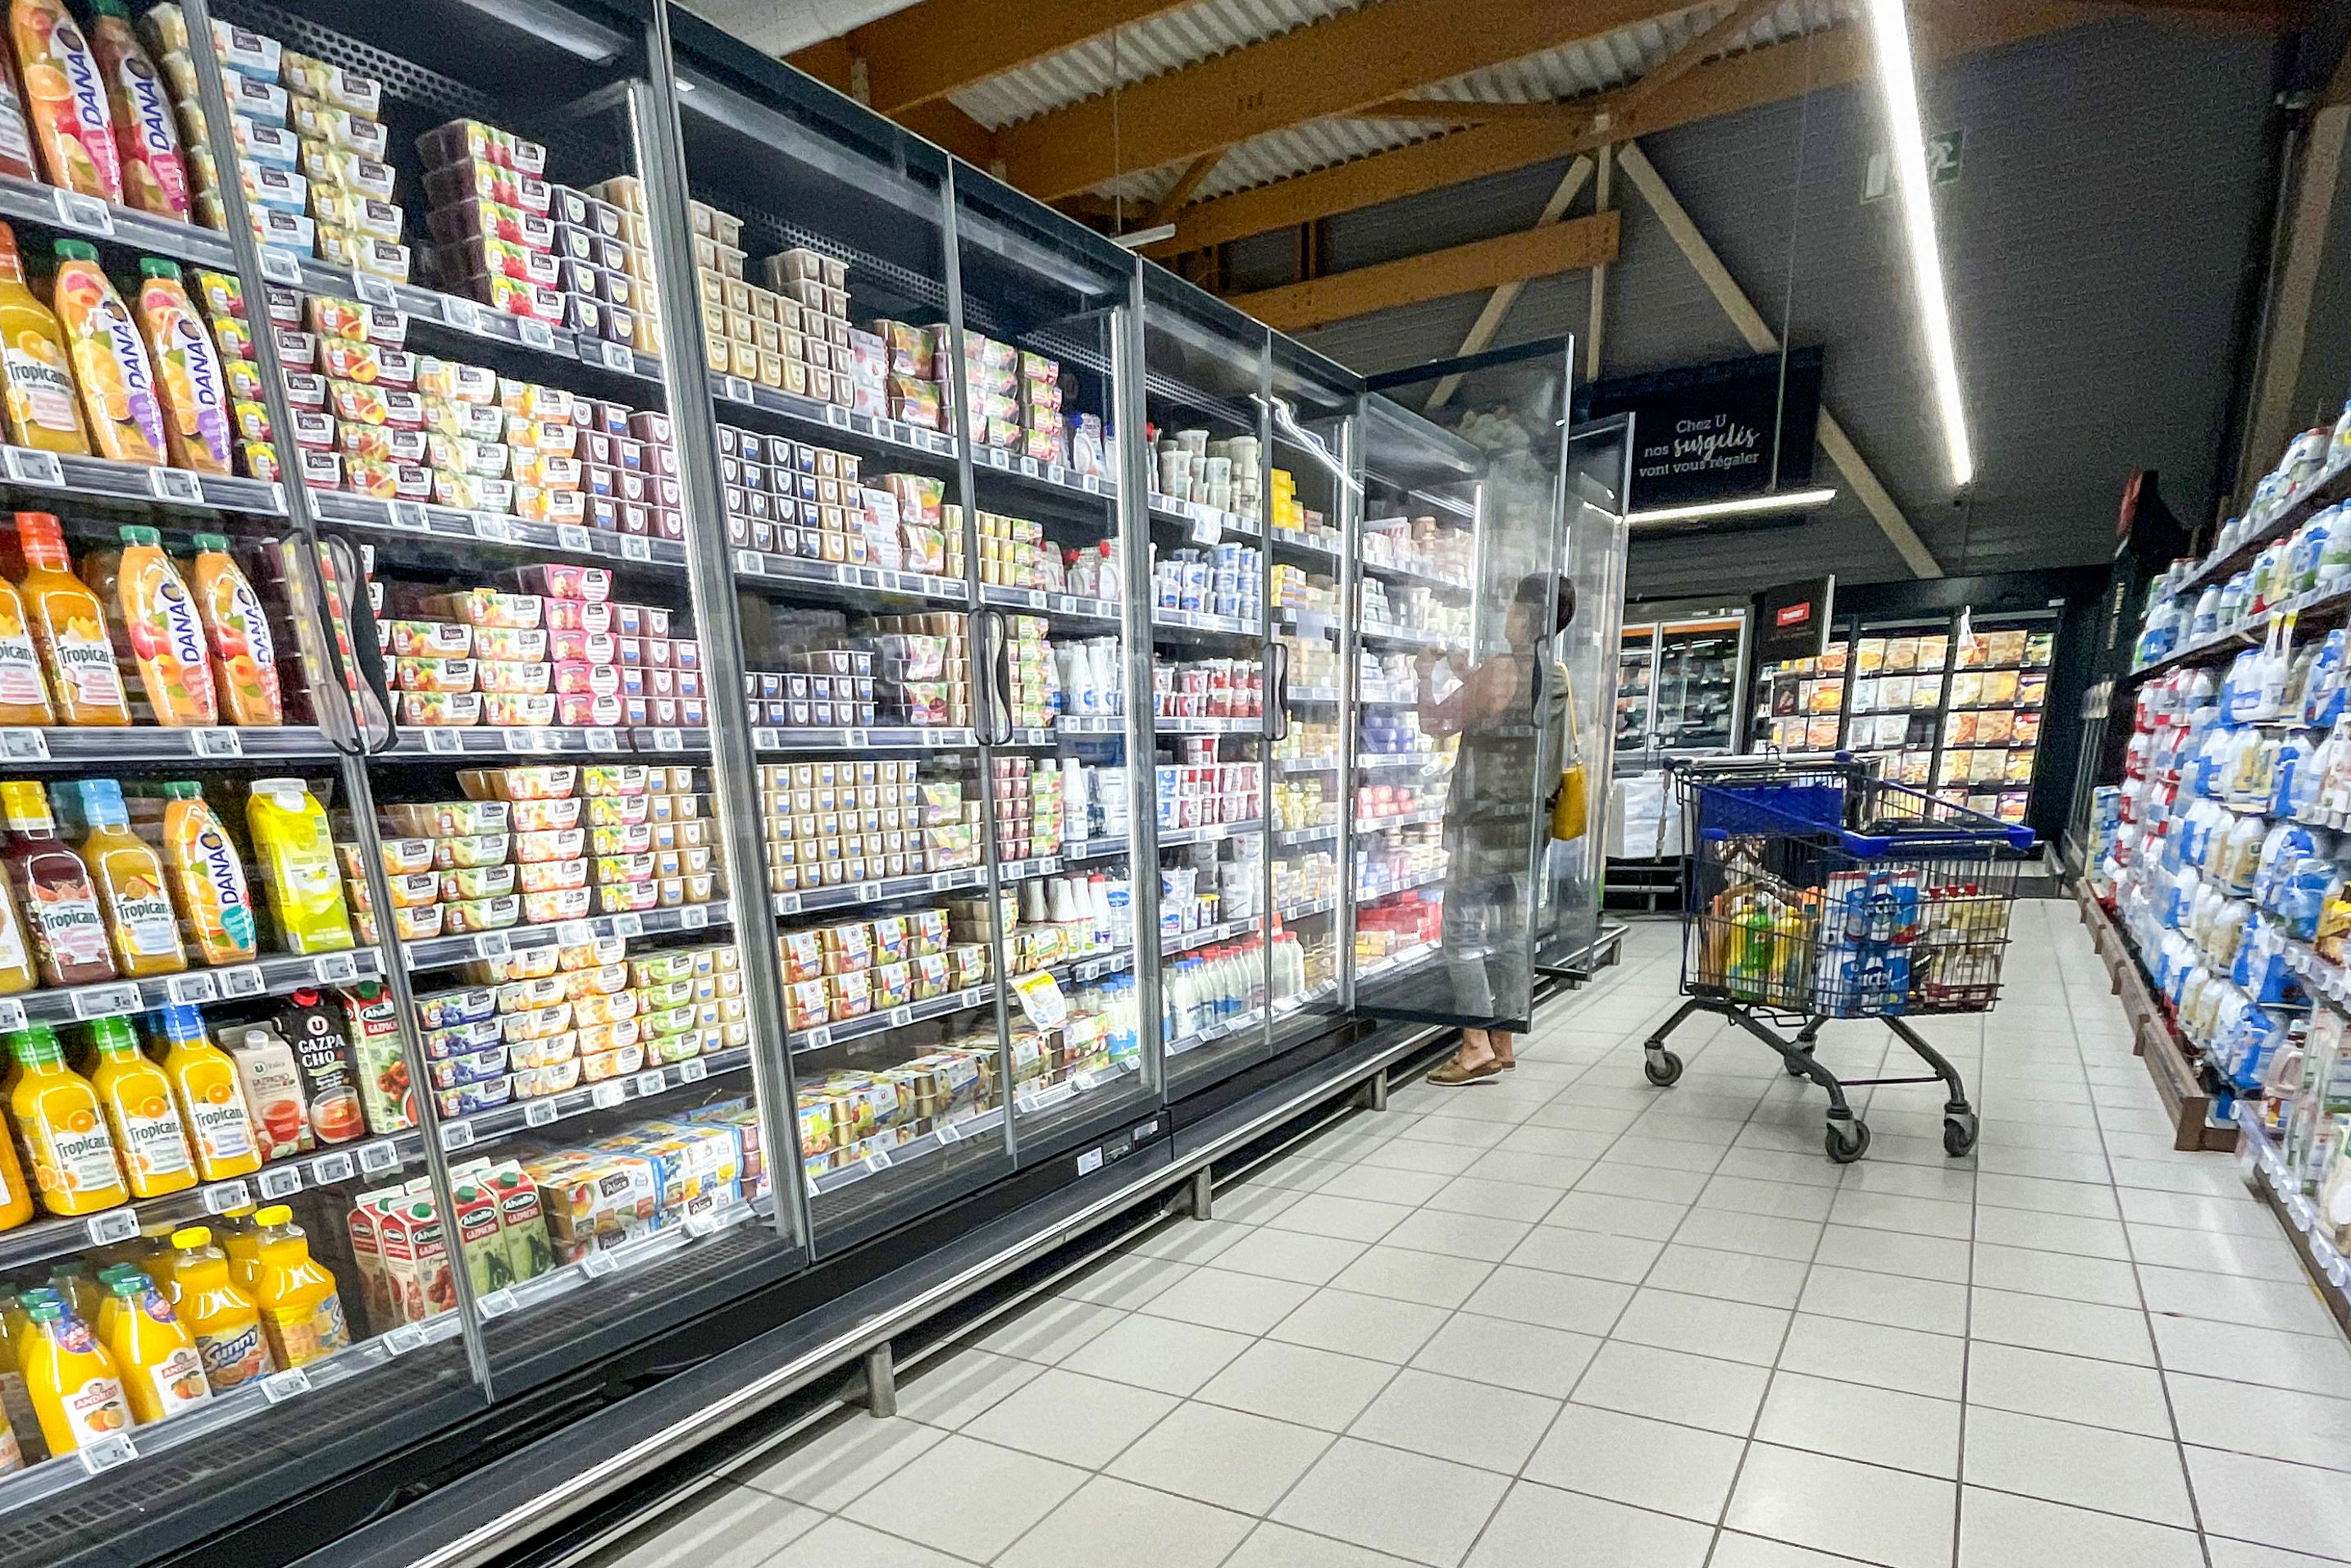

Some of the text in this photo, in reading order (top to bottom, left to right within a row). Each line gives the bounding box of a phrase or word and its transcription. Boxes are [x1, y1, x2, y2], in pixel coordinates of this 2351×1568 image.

[56, 27, 103, 127] DANAO
[125, 57, 171, 151] DANAO
[178, 318, 216, 406] DANAO
[7, 361, 72, 388] Tropican
[1675, 413, 1727, 433] Chez U
[1644, 422, 1761, 461] nos surgelés
[1639, 453, 1760, 477] vont vous régaler
[160, 582, 200, 662] DANAO
[199, 831, 239, 905] DANAO
[43, 909, 101, 930] Tropican
[116, 900, 170, 919] Tropican
[312, 1019, 324, 1032] U
[298, 1034, 346, 1054] GAZPA
[255, 1064, 264, 1073] U
[302, 1050, 335, 1068] CHO
[195, 1106, 244, 1129] Tropican
[129, 1120, 184, 1144] Tropican
[606, 1180, 628, 1195] Alice
[603, 1235, 626, 1249] Alice
[204, 1324, 257, 1370] Sunny
[75, 1385, 118, 1406] ANDROS
